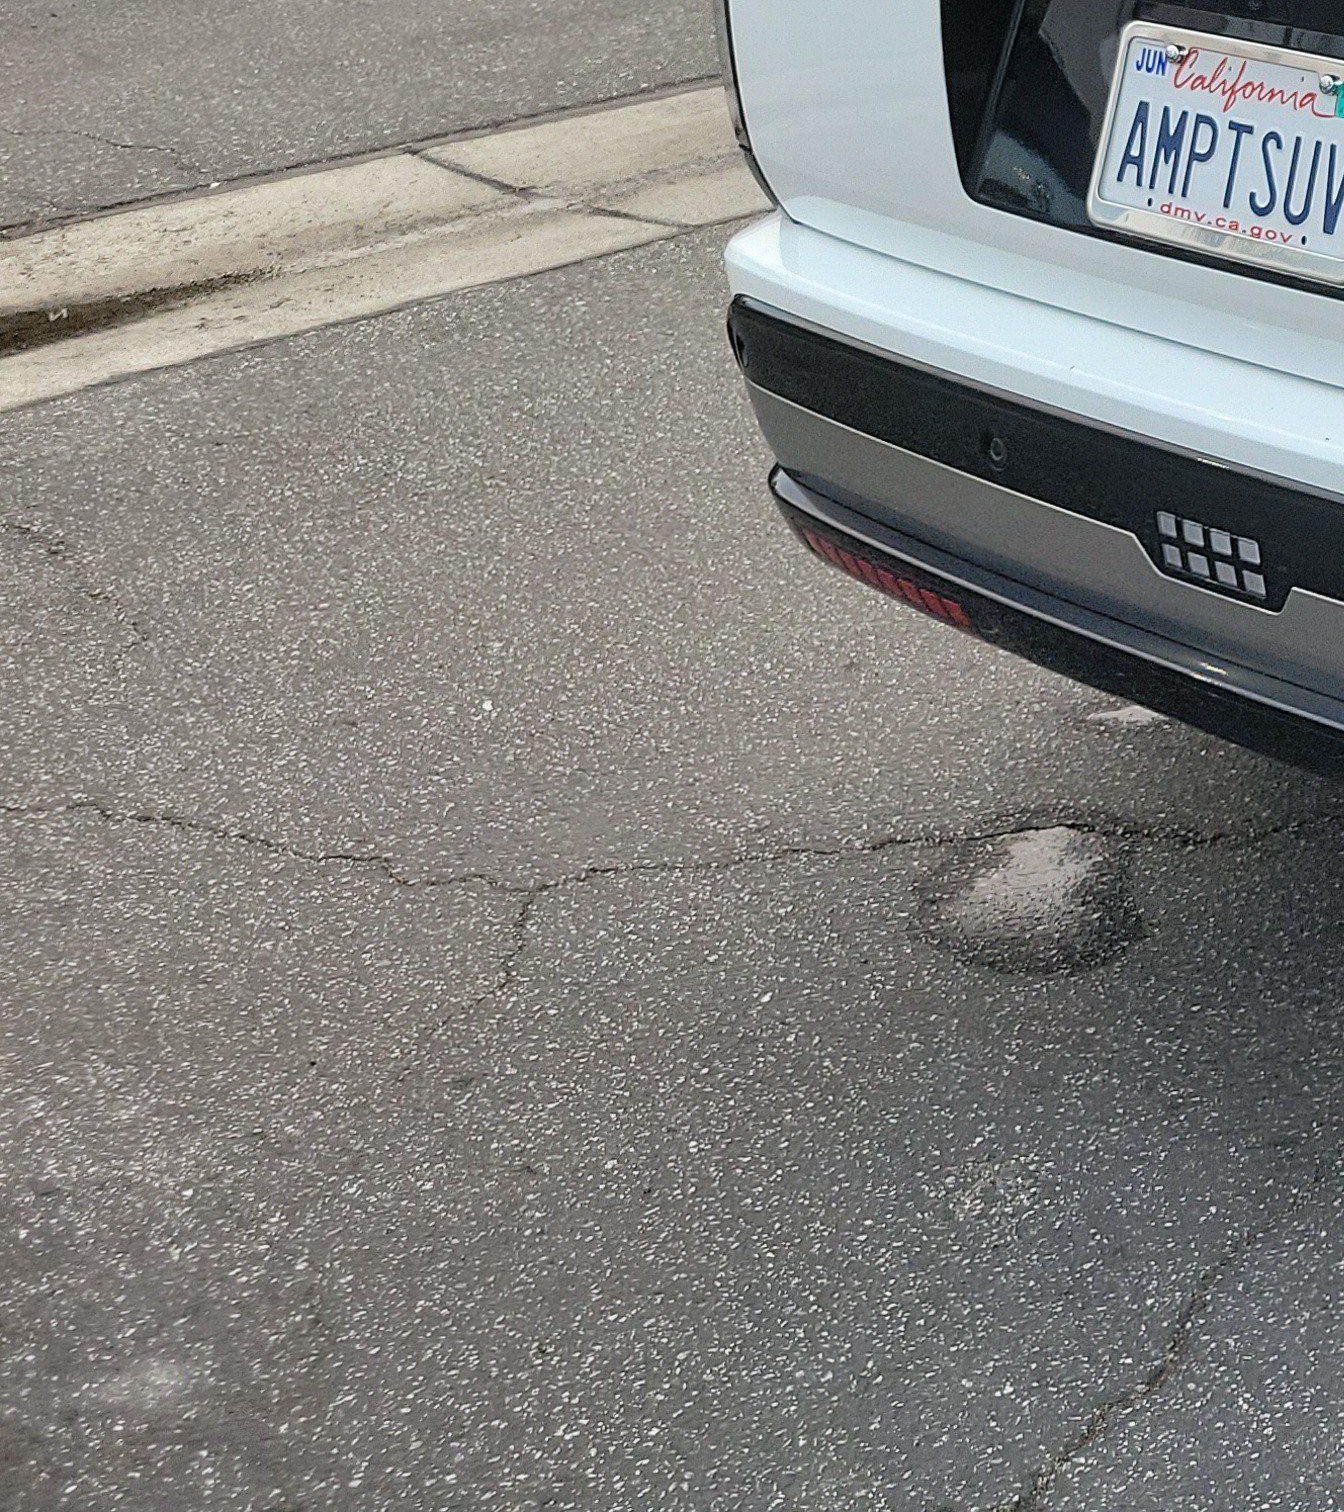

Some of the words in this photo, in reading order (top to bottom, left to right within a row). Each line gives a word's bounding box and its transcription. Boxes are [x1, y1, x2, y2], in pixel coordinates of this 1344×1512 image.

[1136, 47, 1168, 76] JUN
[1173, 47, 1335, 119] California
[1160, 201, 1292, 244] dmv.ca.gov
